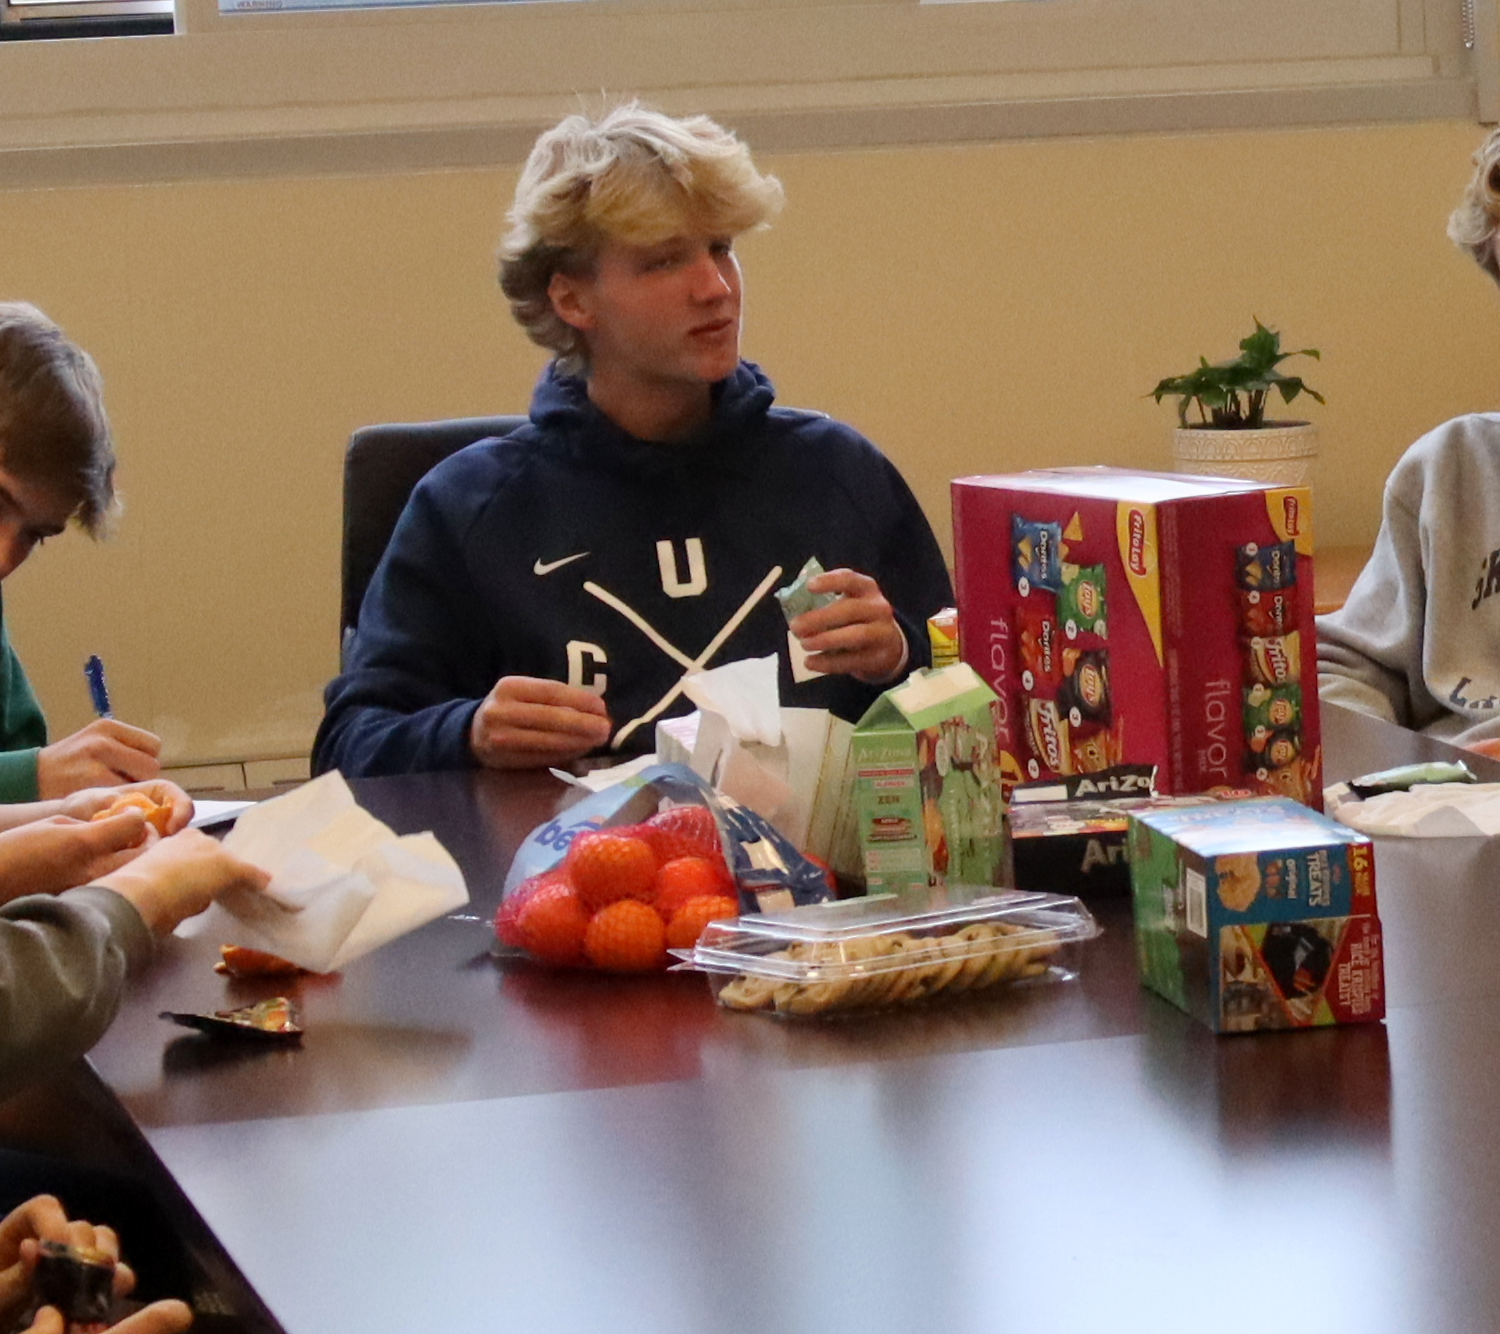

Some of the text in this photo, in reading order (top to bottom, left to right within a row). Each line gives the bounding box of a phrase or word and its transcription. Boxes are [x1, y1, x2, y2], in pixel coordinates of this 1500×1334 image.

[655, 537, 708, 598] U
[1041, 620, 1051, 673] Doritos
[989, 617, 1010, 743] flavor
[1038, 701, 1059, 767] Fritos
[1205, 678, 1231, 778] flavor
[1075, 773, 1151, 798] AriZo
[1306, 852, 1320, 908] TREATS
[1352, 846, 1369, 872] 16
